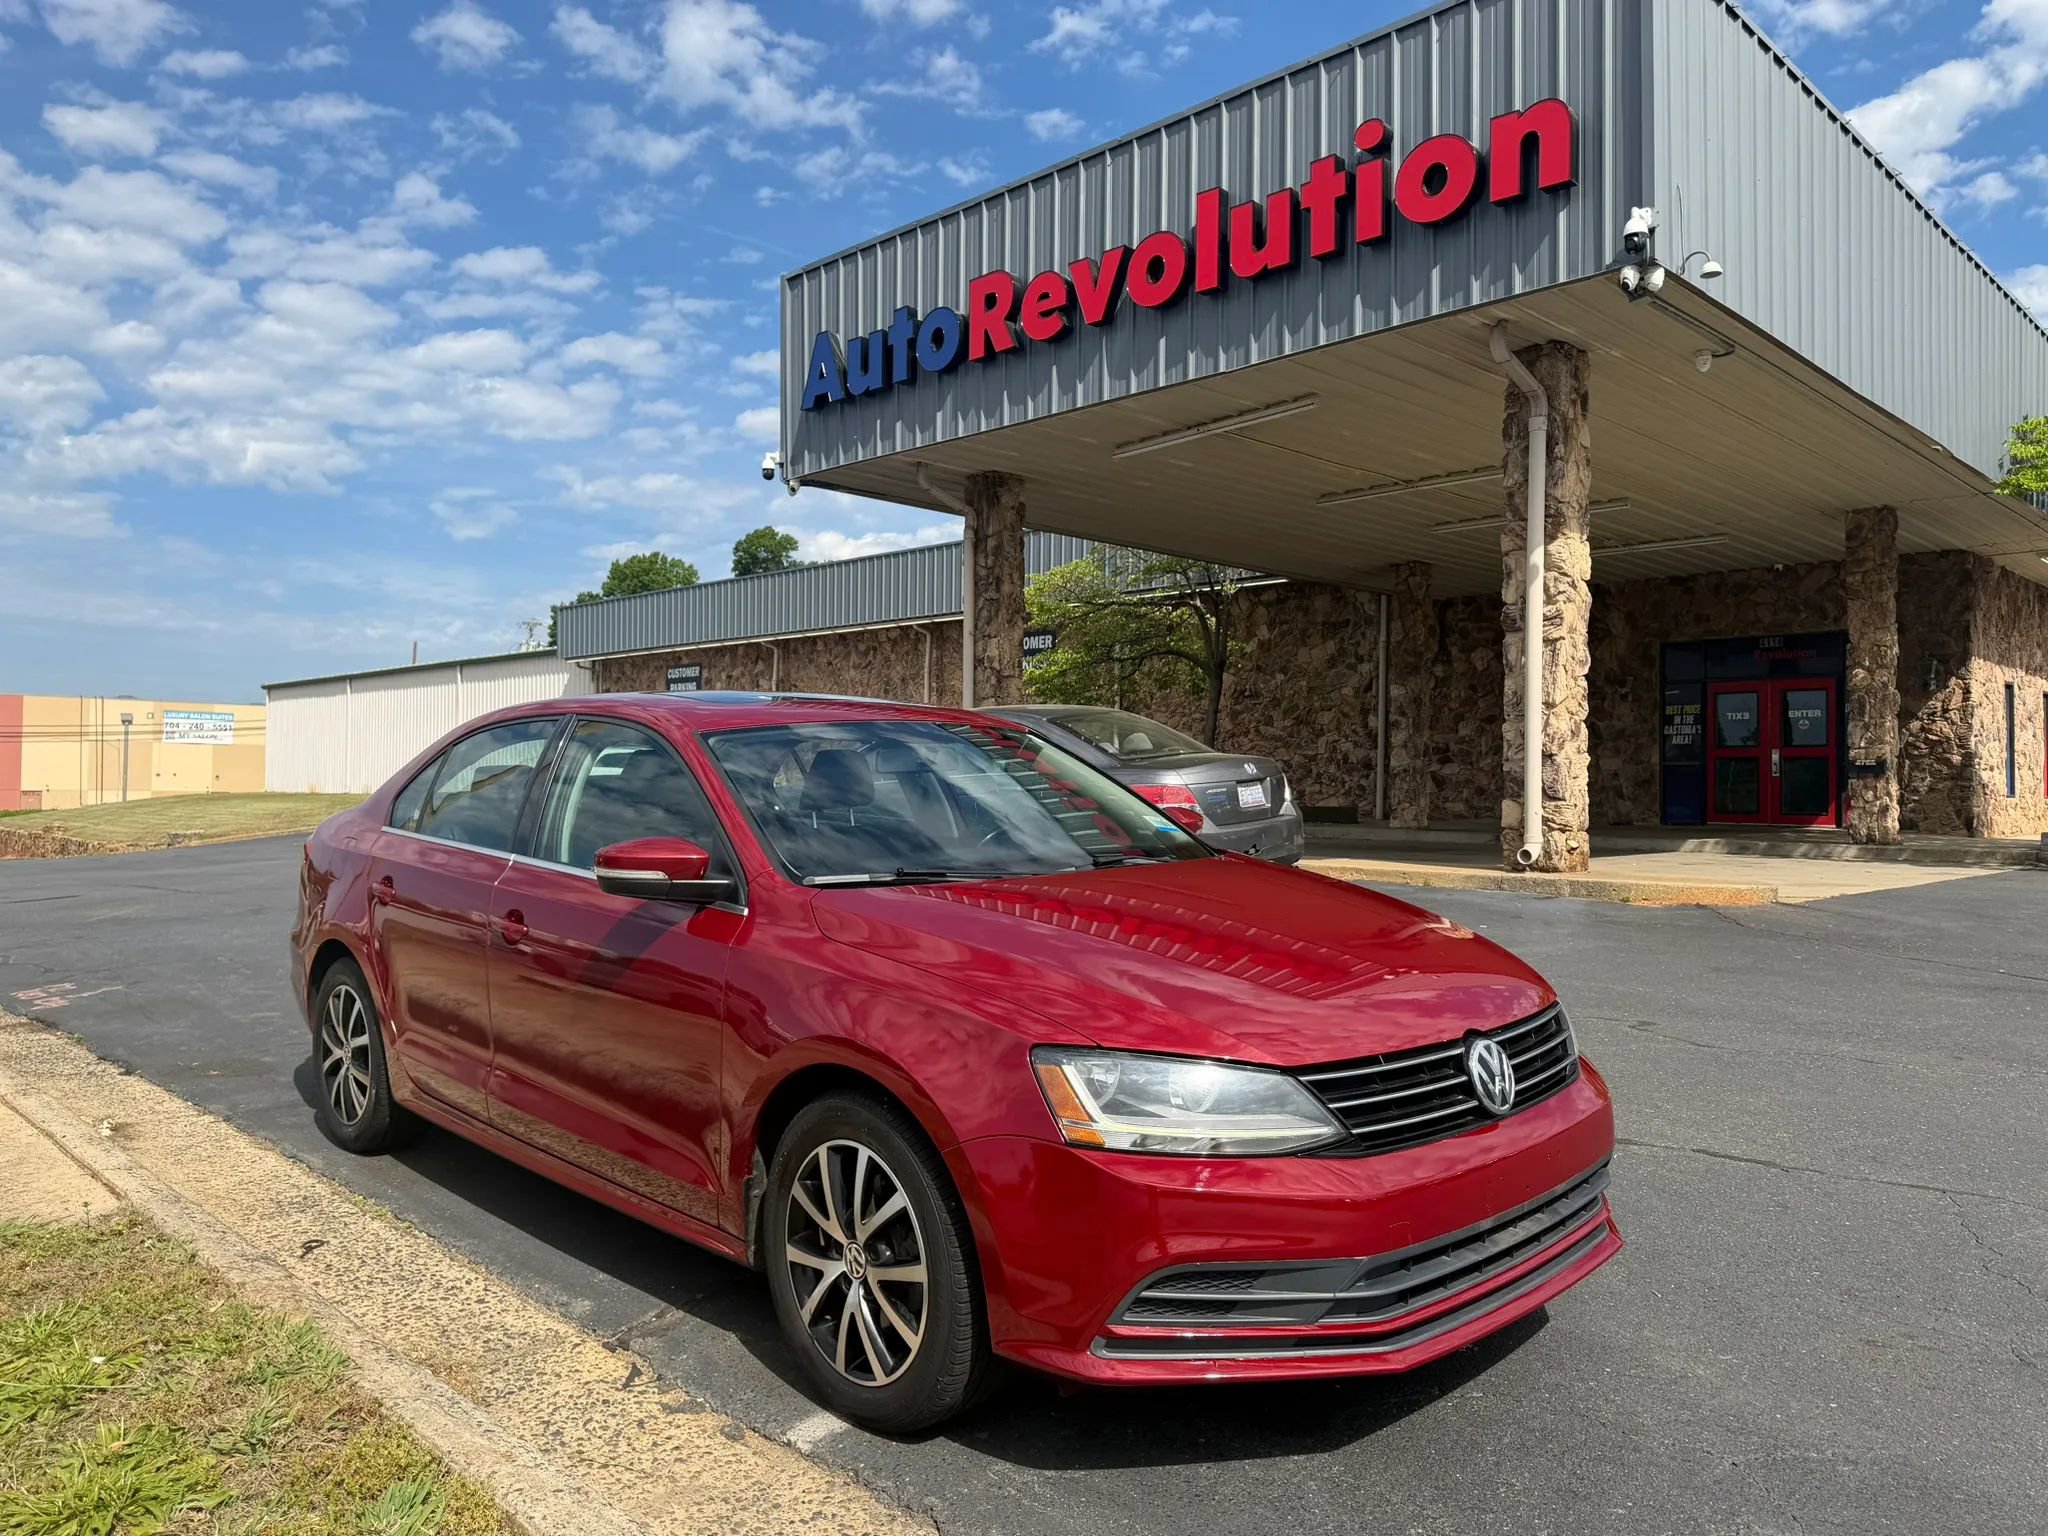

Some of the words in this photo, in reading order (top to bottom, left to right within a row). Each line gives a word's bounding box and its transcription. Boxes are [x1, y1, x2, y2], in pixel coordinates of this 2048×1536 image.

[802, 98, 1577, 411] AutoRevolution
[667, 666, 700, 679] CUSTOMER
[670, 682, 697, 691] PARKING
[1665, 705, 1682, 715] BEST
[1788, 709, 1822, 718] ENTER
[1672, 735, 1692, 745] AREA!
